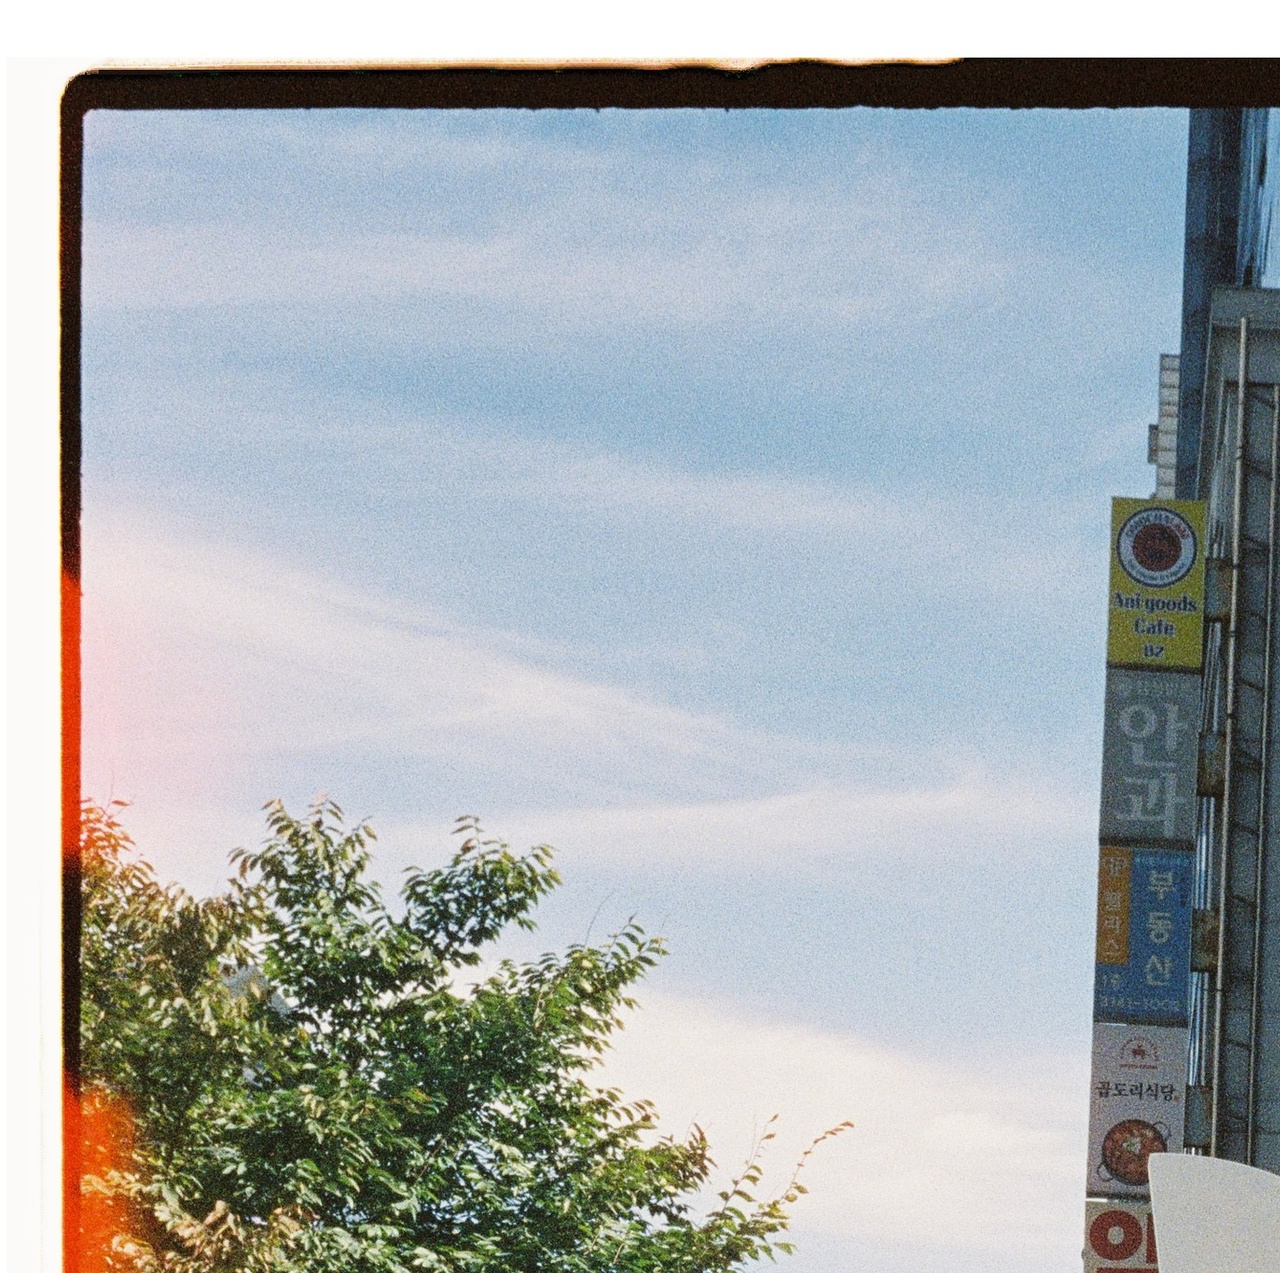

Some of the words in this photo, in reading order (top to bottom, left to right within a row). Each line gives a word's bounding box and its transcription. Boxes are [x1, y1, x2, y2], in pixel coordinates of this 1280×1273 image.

[1134, 618, 1175, 636] Cafe
[1114, 703, 1188, 838] 안과
[1145, 870, 1175, 986] 부동산
